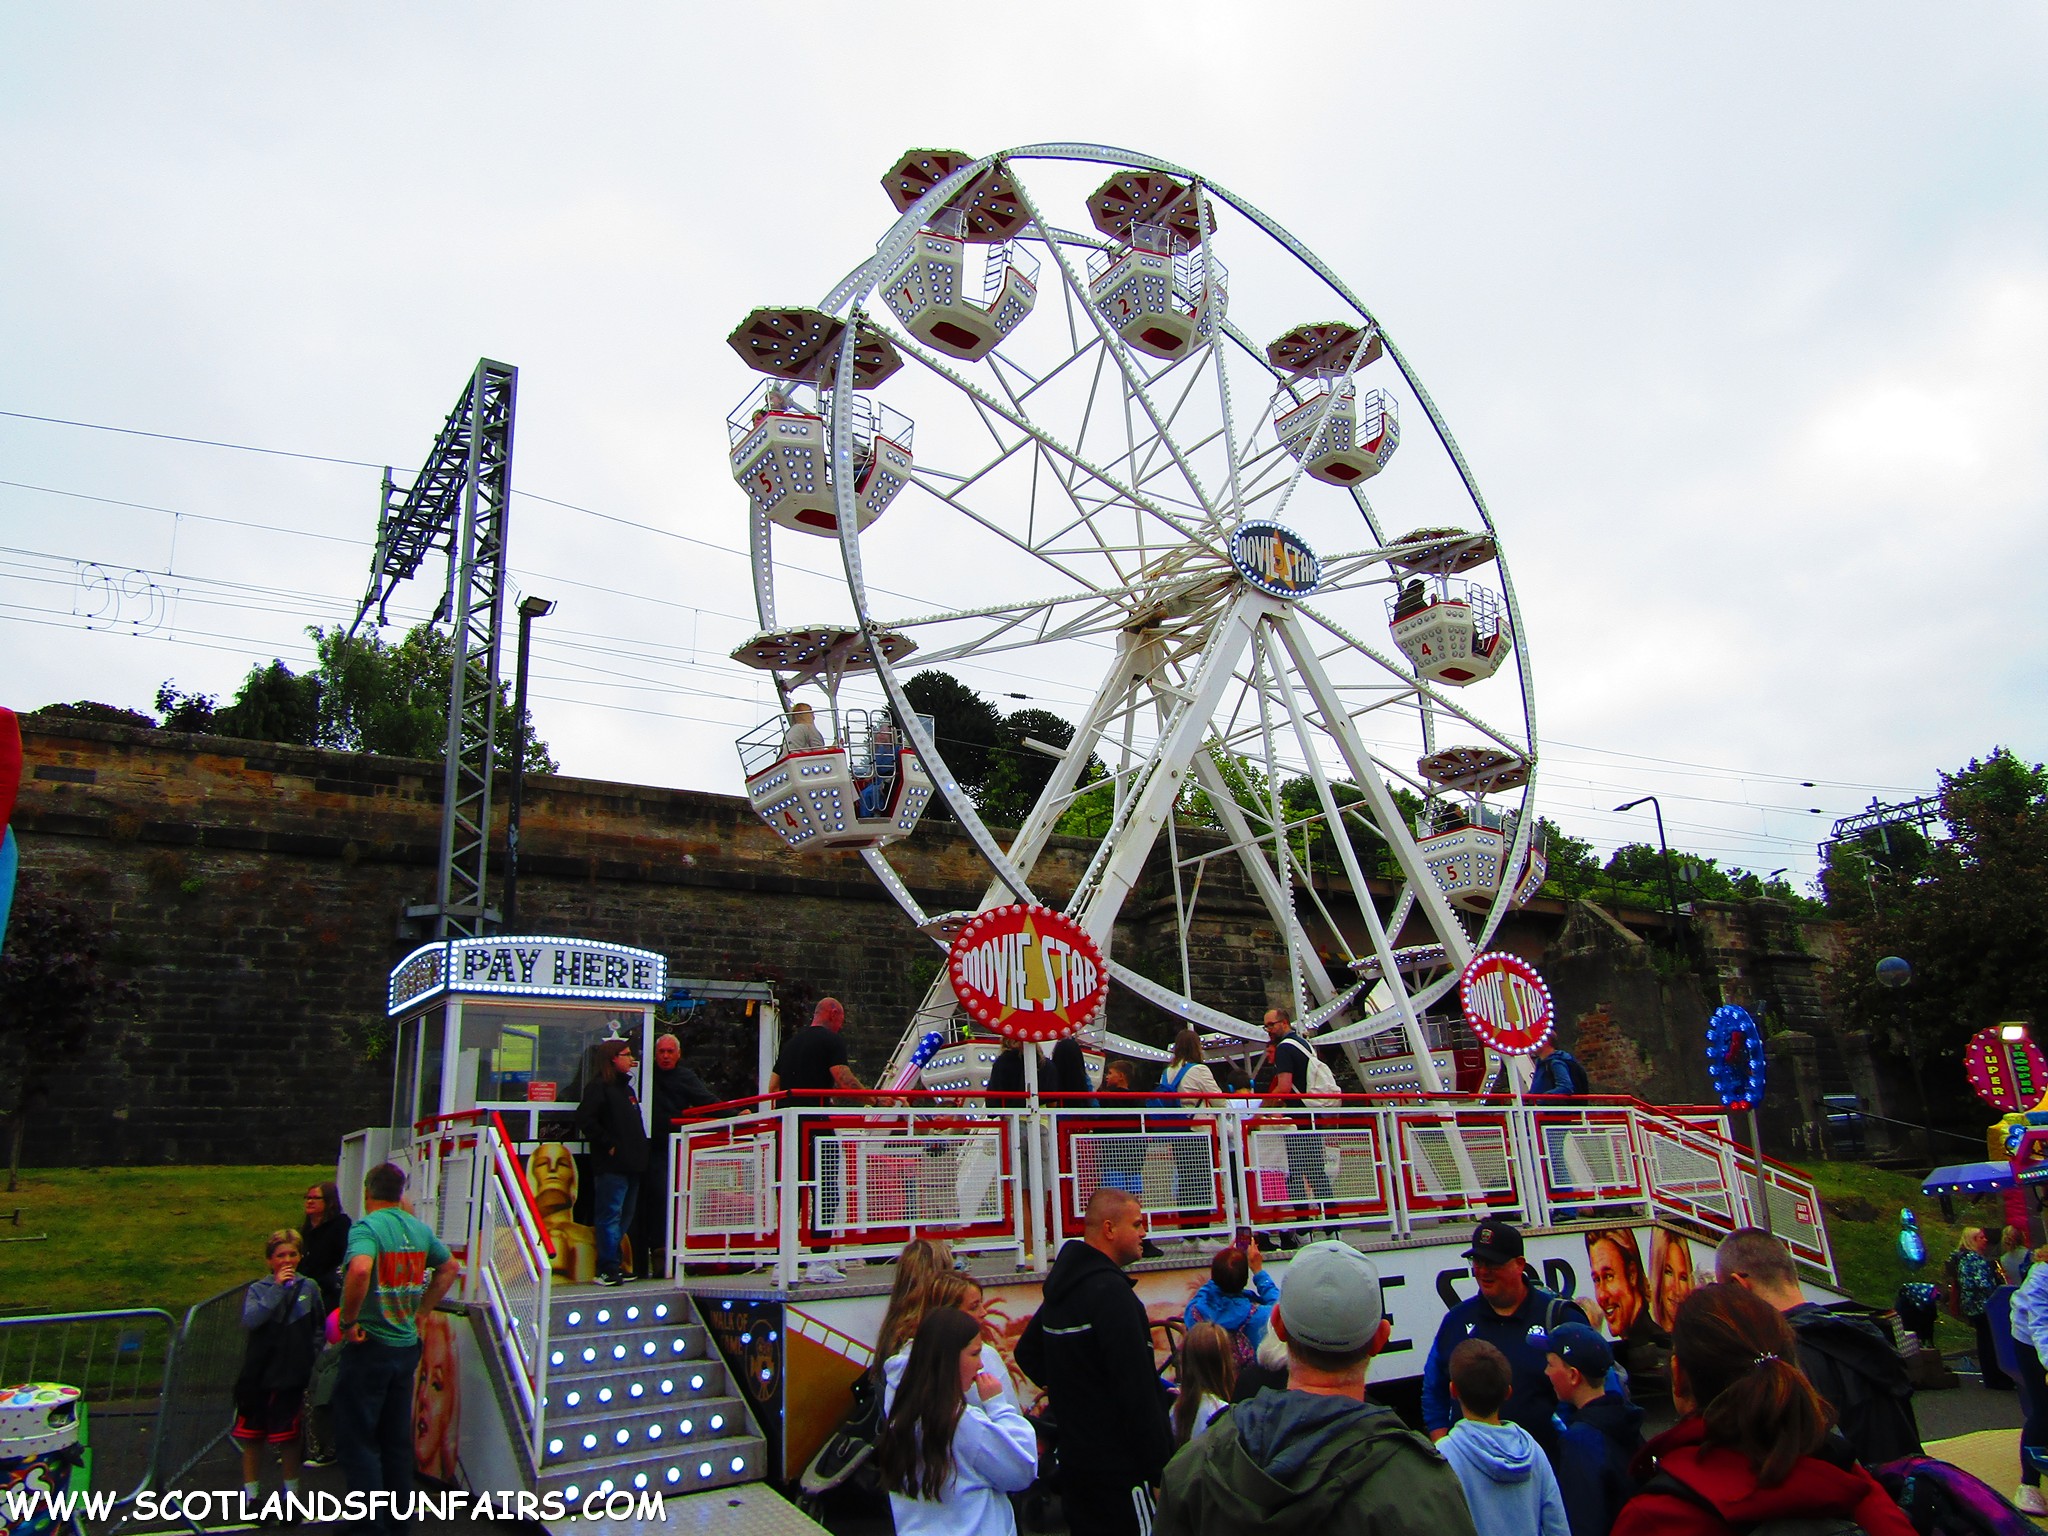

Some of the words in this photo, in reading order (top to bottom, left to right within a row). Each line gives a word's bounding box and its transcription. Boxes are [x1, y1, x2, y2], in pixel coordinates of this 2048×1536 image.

[902, 287, 913, 304] 1
[1118, 299, 1131, 315] 2
[759, 472, 772, 493] 5
[1283, 542, 1318, 582] STAR
[1421, 643, 1432, 656] 4
[784, 811, 799, 828] 4
[1446, 865, 1458, 881] 5
[463, 949, 542, 983] PAY
[552, 950, 652, 989] HERE
[962, 932, 1034, 1011] MOVIE
[1041, 935, 1098, 1011] STAR
[1508, 972, 1545, 1031] STAR
[1984, 1045, 2005, 1096] SUPER
[2012, 1043, 2035, 1095] TROOPER
[710, 1311, 734, 1330] WALK
[736, 1313, 748, 1331] OF
